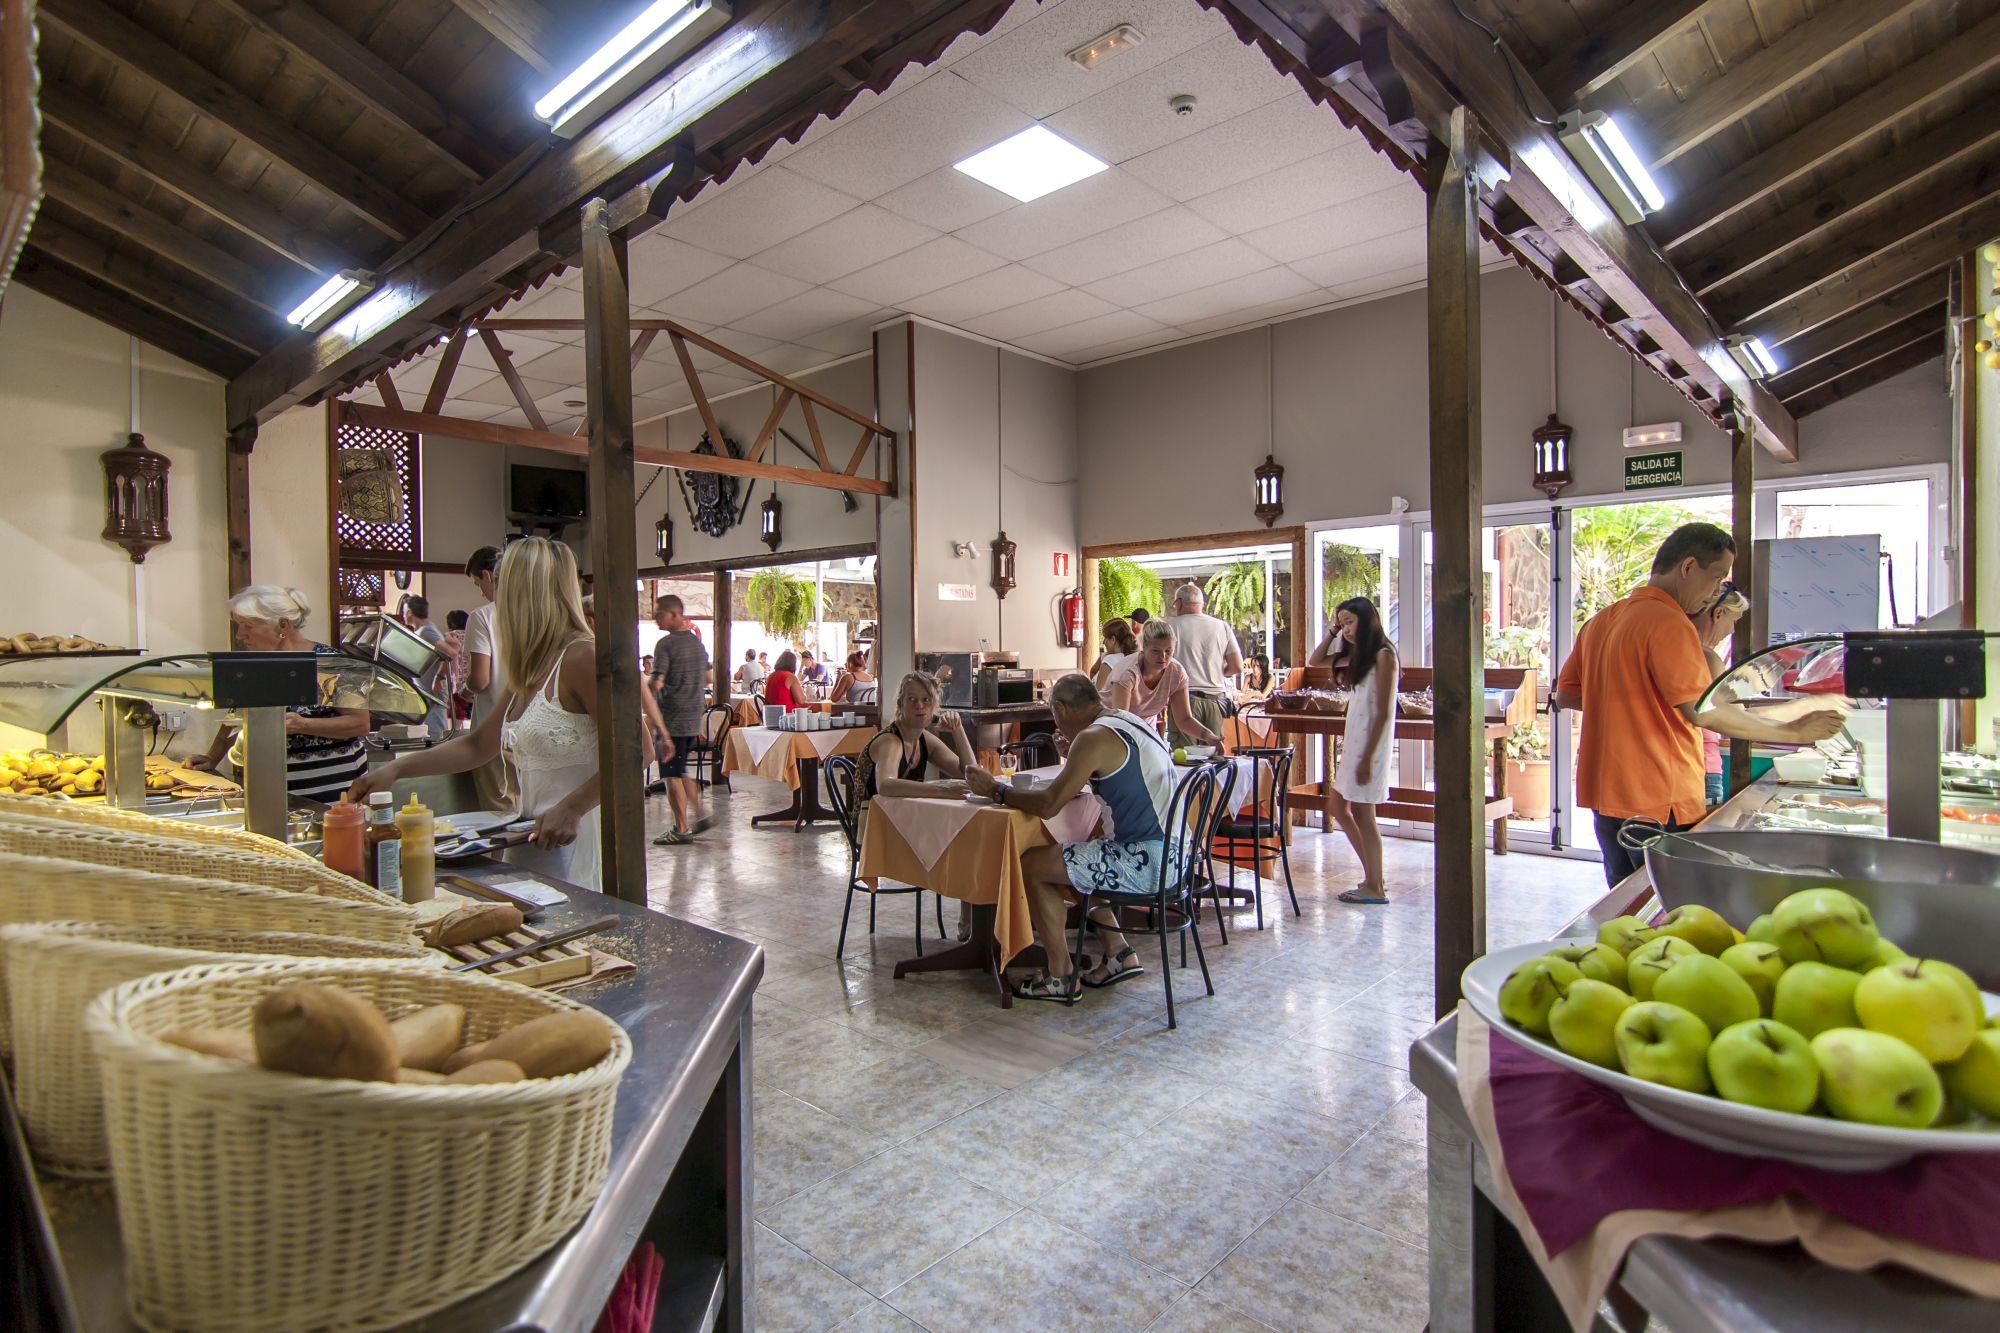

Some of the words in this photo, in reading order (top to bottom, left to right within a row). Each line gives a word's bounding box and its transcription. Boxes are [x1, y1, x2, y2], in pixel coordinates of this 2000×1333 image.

[1631, 458, 1662, 471] SALIDA
[1663, 457, 1676, 468] DE
[1625, 471, 1682, 486] EMERGENCIA
